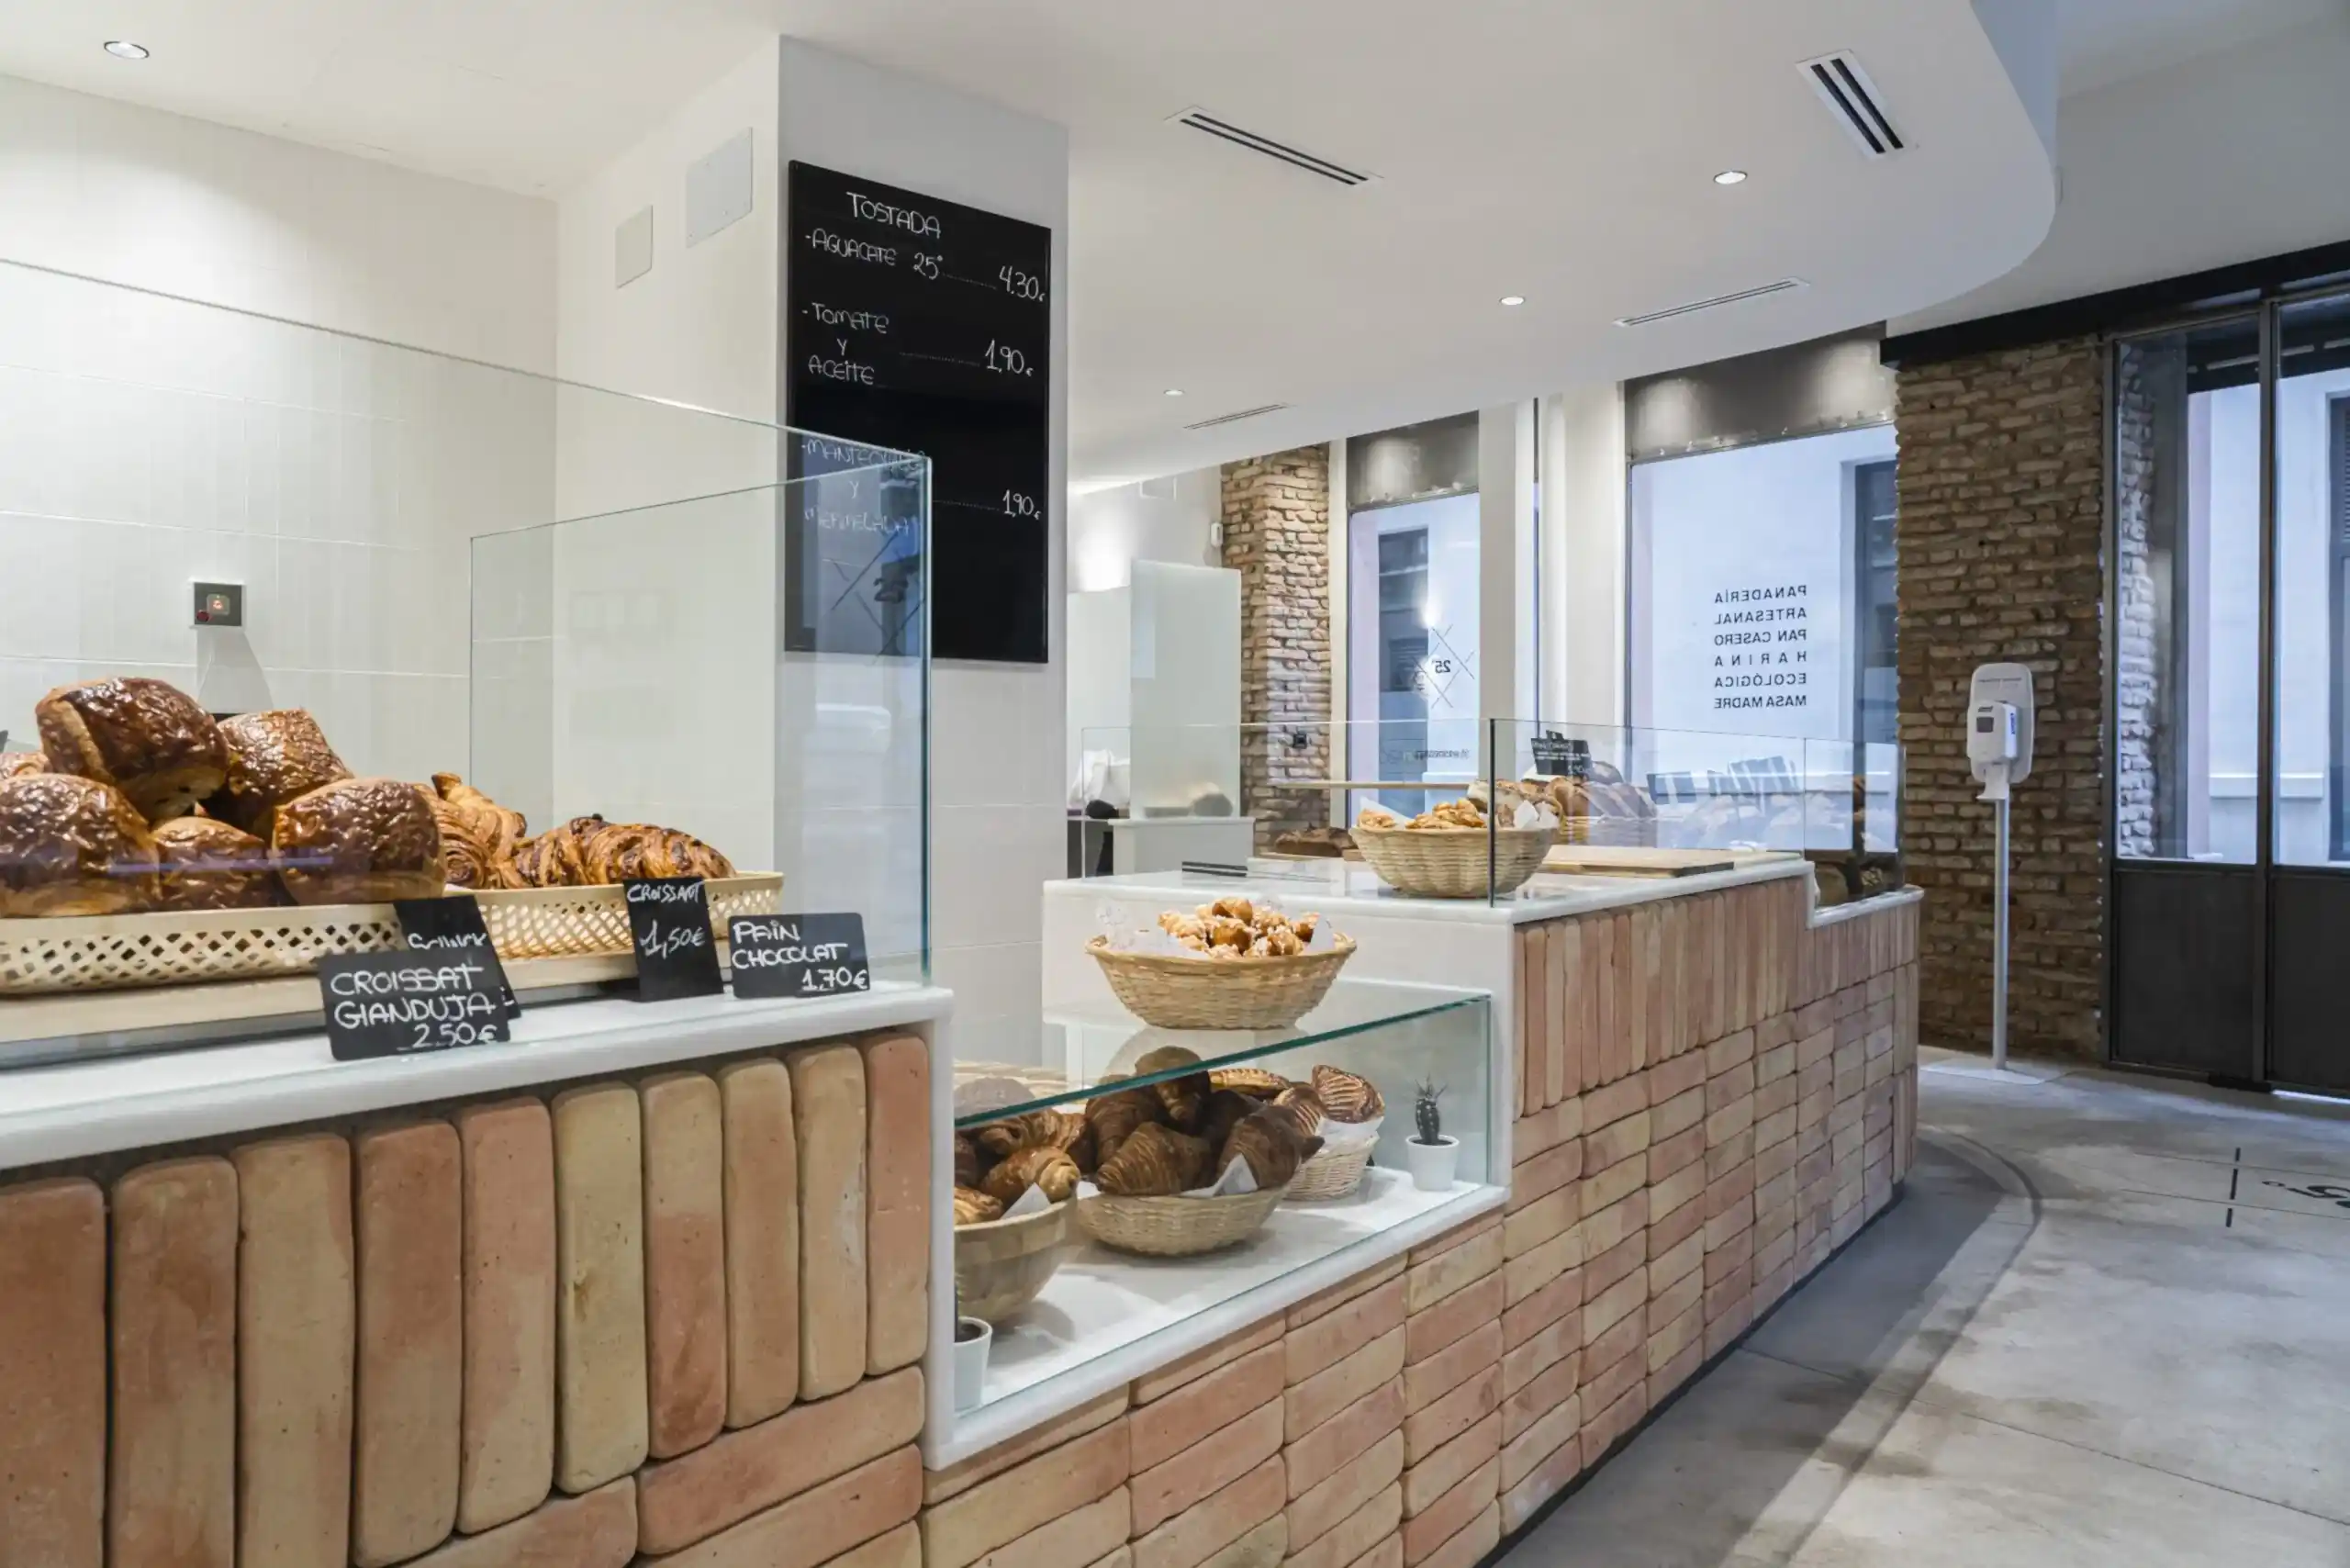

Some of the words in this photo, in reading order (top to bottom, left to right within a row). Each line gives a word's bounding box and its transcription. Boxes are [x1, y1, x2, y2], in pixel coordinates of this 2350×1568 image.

[846, 191, 942, 240] TOSTADA
[639, 920, 706, 959] 1,50€
[732, 943, 848, 969] CHOCOLAT
[334, 992, 497, 1029] GIANDUJA
